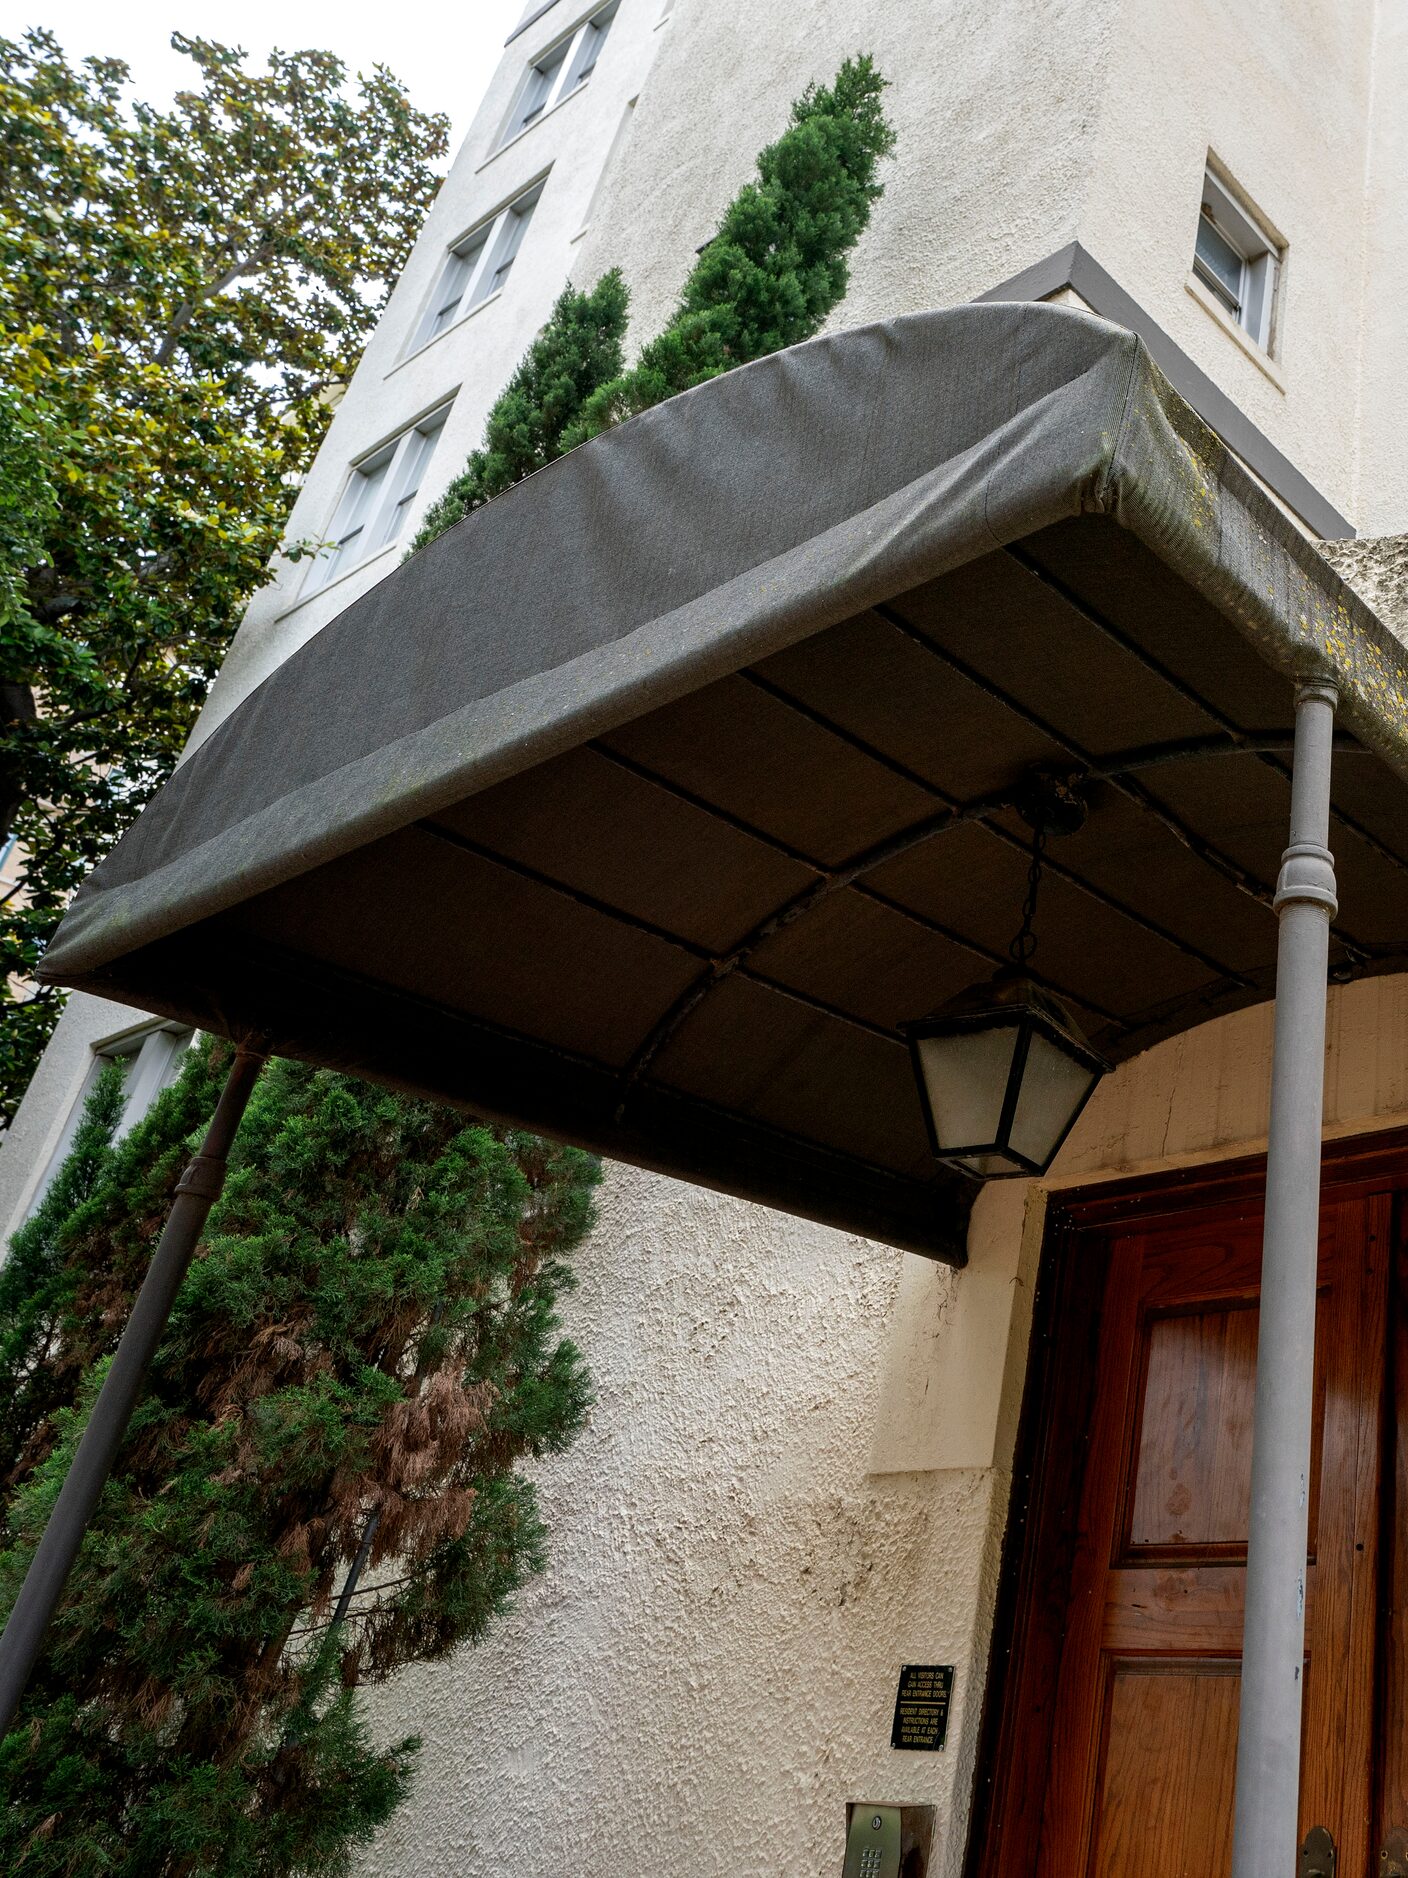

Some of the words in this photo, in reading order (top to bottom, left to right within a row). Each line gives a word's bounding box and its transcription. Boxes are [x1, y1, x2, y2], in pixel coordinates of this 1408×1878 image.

[935, 1672, 944, 1680] CAN
[933, 1681, 944, 1689] THRU
[912, 1690, 932, 1698] ENTRANCE
[900, 1707, 918, 1715] RESIDENT
[918, 1708, 940, 1716] DIRECTORY
[903, 1717, 930, 1725] INSTRUCTIONS
[930, 1717, 938, 1725] ARE
[901, 1726, 920, 1734] AVAILABLE
[927, 1727, 938, 1735] EACH
[902, 1735, 912, 1743] REAR
